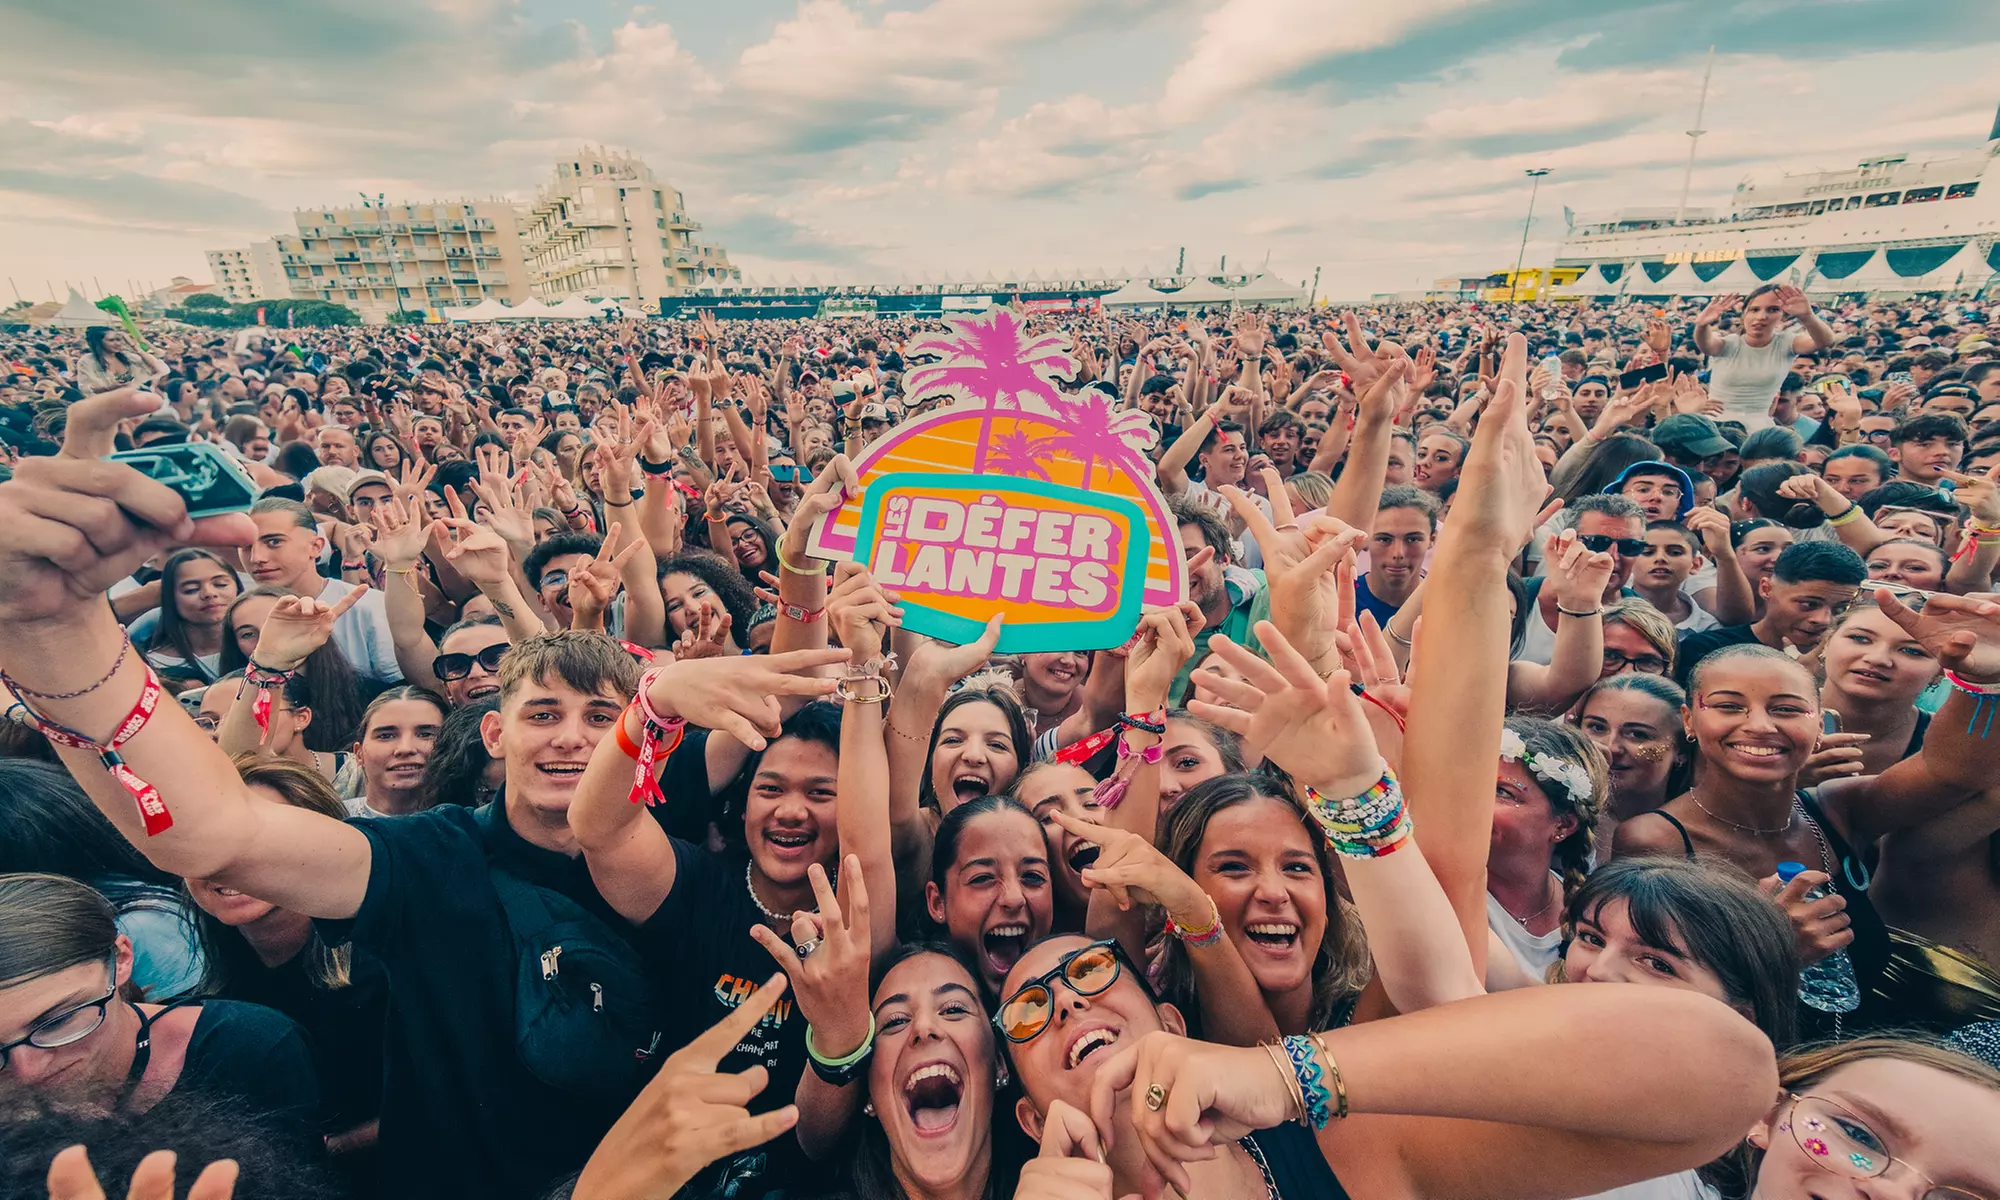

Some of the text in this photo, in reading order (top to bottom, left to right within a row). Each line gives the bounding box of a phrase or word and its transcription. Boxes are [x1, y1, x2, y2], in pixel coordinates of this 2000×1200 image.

[883, 496, 909, 538] LES
[905, 495, 1114, 561] DÉFER
[872, 540, 1110, 608] LANTES
